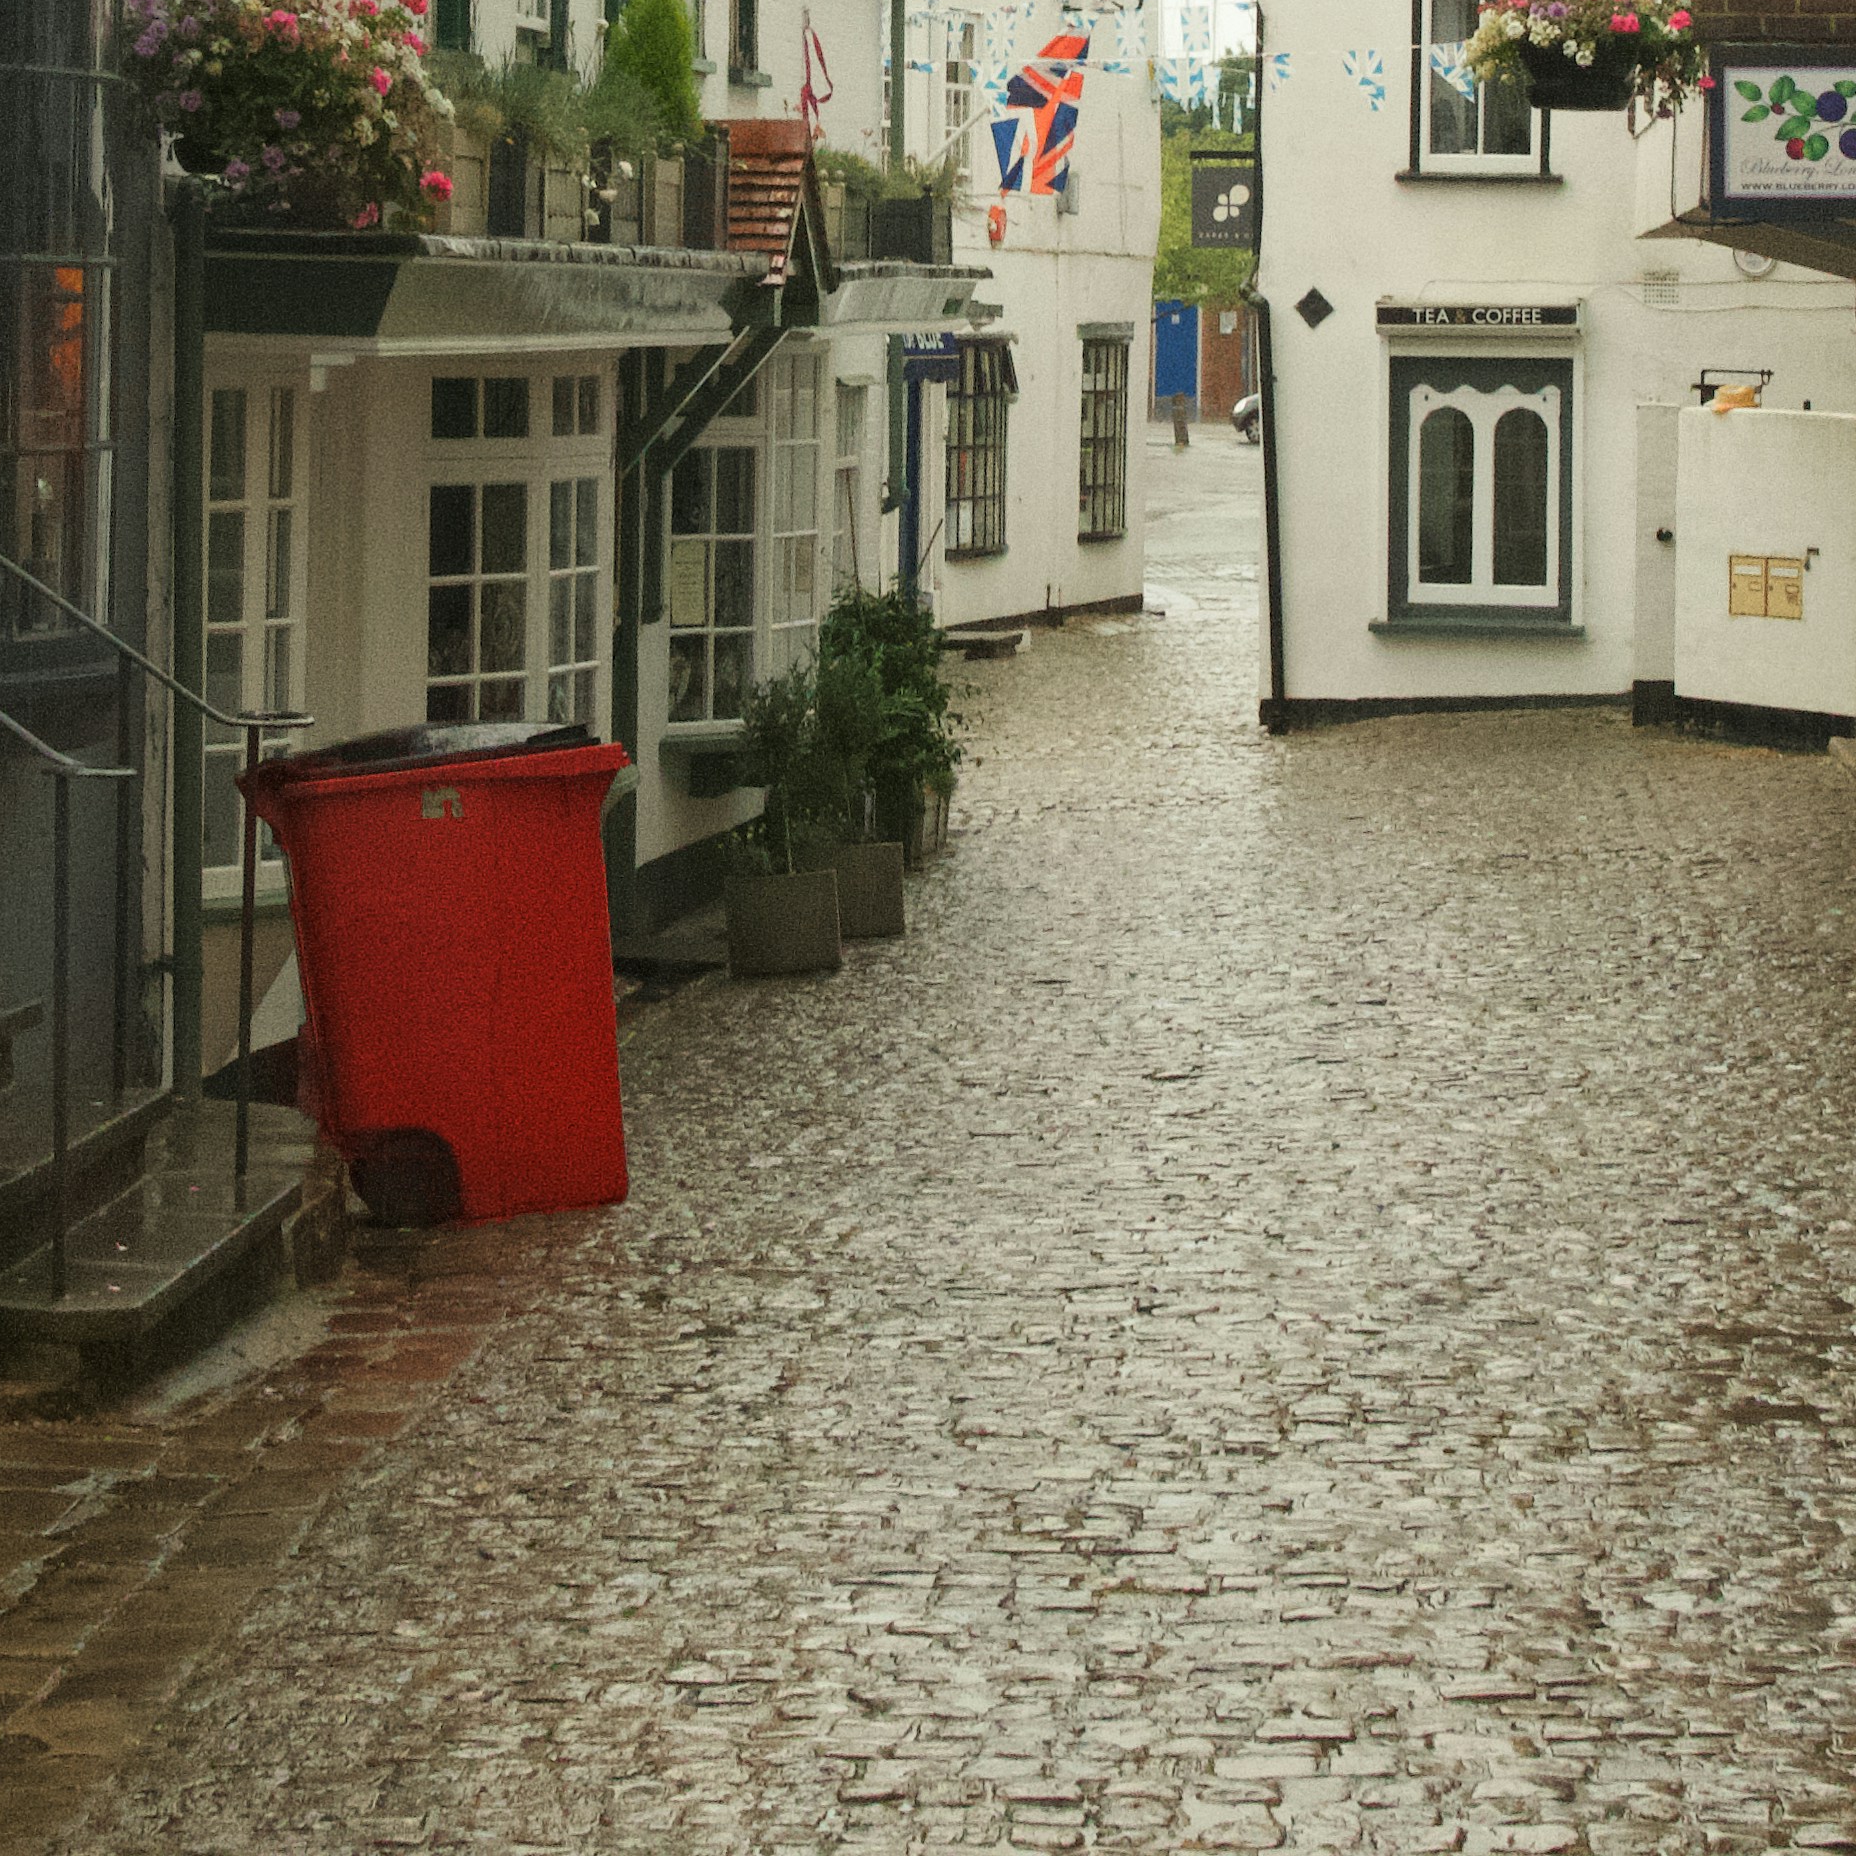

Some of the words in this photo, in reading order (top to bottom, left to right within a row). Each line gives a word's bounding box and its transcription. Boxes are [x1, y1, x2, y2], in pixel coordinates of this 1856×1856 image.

[1412, 308, 1450, 324] TEA
[1456, 309, 1466, 324] &
[1472, 308, 1542, 324] COFFEE
